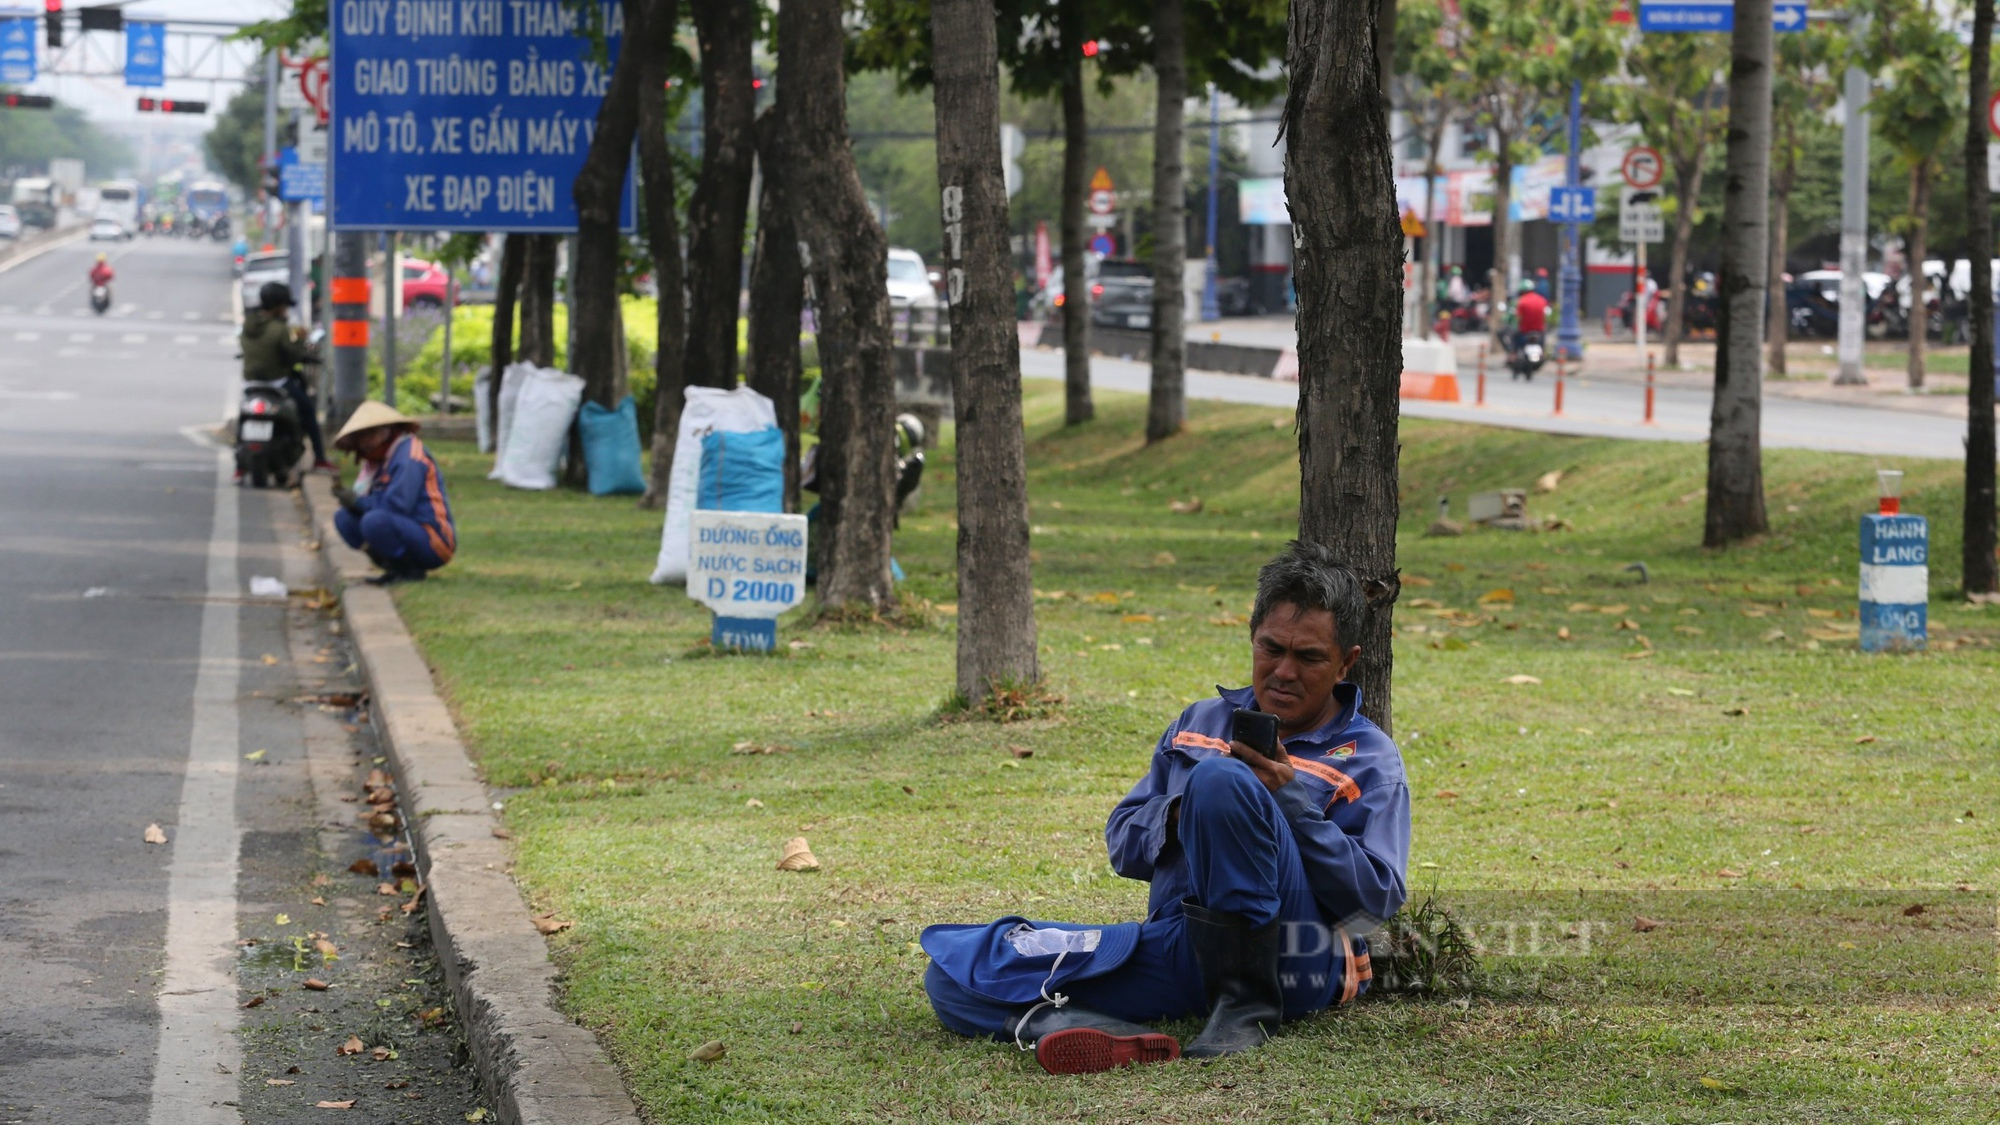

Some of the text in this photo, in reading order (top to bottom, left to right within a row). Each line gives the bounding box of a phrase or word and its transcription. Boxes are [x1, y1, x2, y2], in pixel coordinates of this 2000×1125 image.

[342, 0, 392, 36] QUY
[395, 0, 451, 42] ĐỊNH
[460, 0, 503, 36] KHI
[354, 58, 410, 96] GIAO
[416, 52, 498, 96] THÔNG
[508, 44, 576, 97] BẰNG
[344, 110, 380, 153] MÔ
[386, 110, 425, 155] TÔ,
[430, 117, 463, 154] XE
[527, 109, 579, 154] MÁY
[404, 169, 555, 218] XE ĐẠP ĐIỆN
[765, 524, 803, 547] ỐNG
[1874, 519, 1927, 540] HÀNH
[1872, 545, 1926, 564] LANG
[708, 577, 795, 603] D 2000
